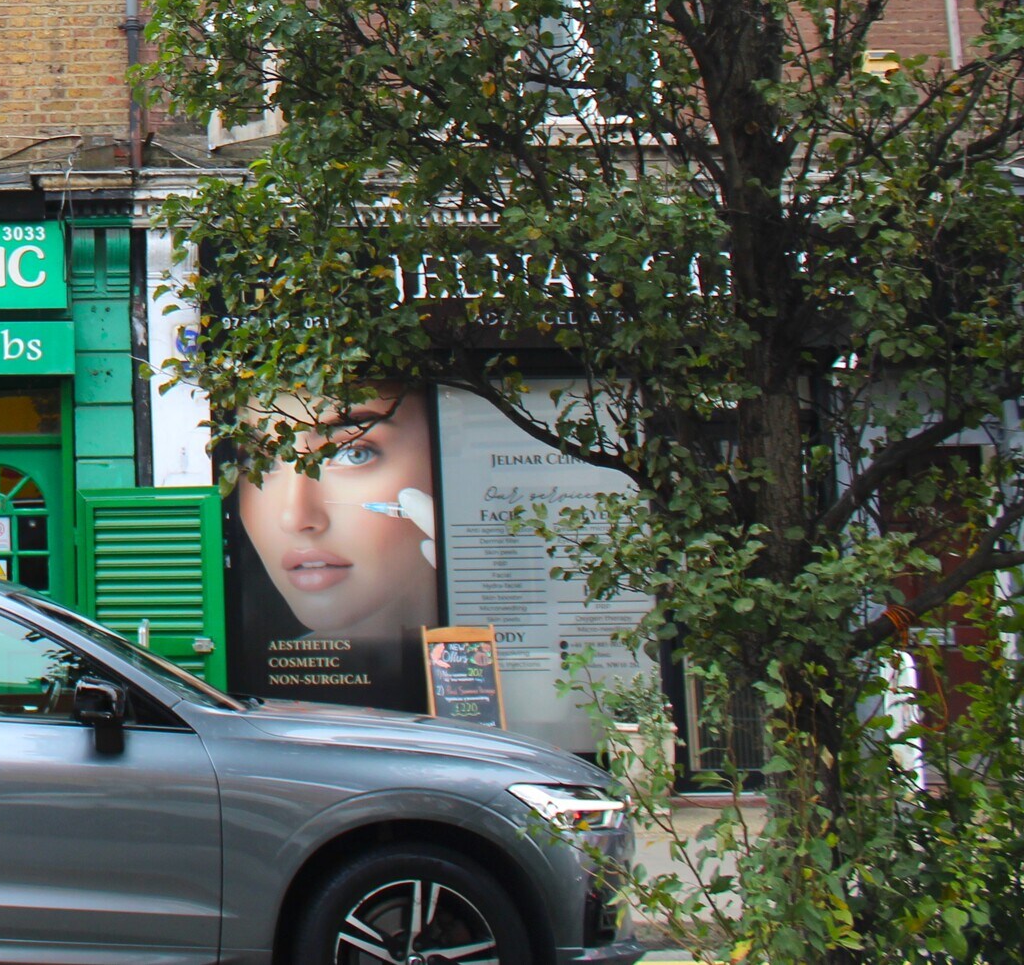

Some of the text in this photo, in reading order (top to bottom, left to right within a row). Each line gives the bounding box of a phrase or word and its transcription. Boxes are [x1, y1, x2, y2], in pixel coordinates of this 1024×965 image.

[2, 226, 46, 241] 3033
[490, 452, 588, 468] JELNAR CLIN
[483, 485, 598, 504] Our service
[494, 631, 526, 644] ODY
[268, 639, 351, 651] AESTHETICS
[268, 656, 340, 668] COSMETIC
[268, 673, 372, 686] NON-SURGICAL
